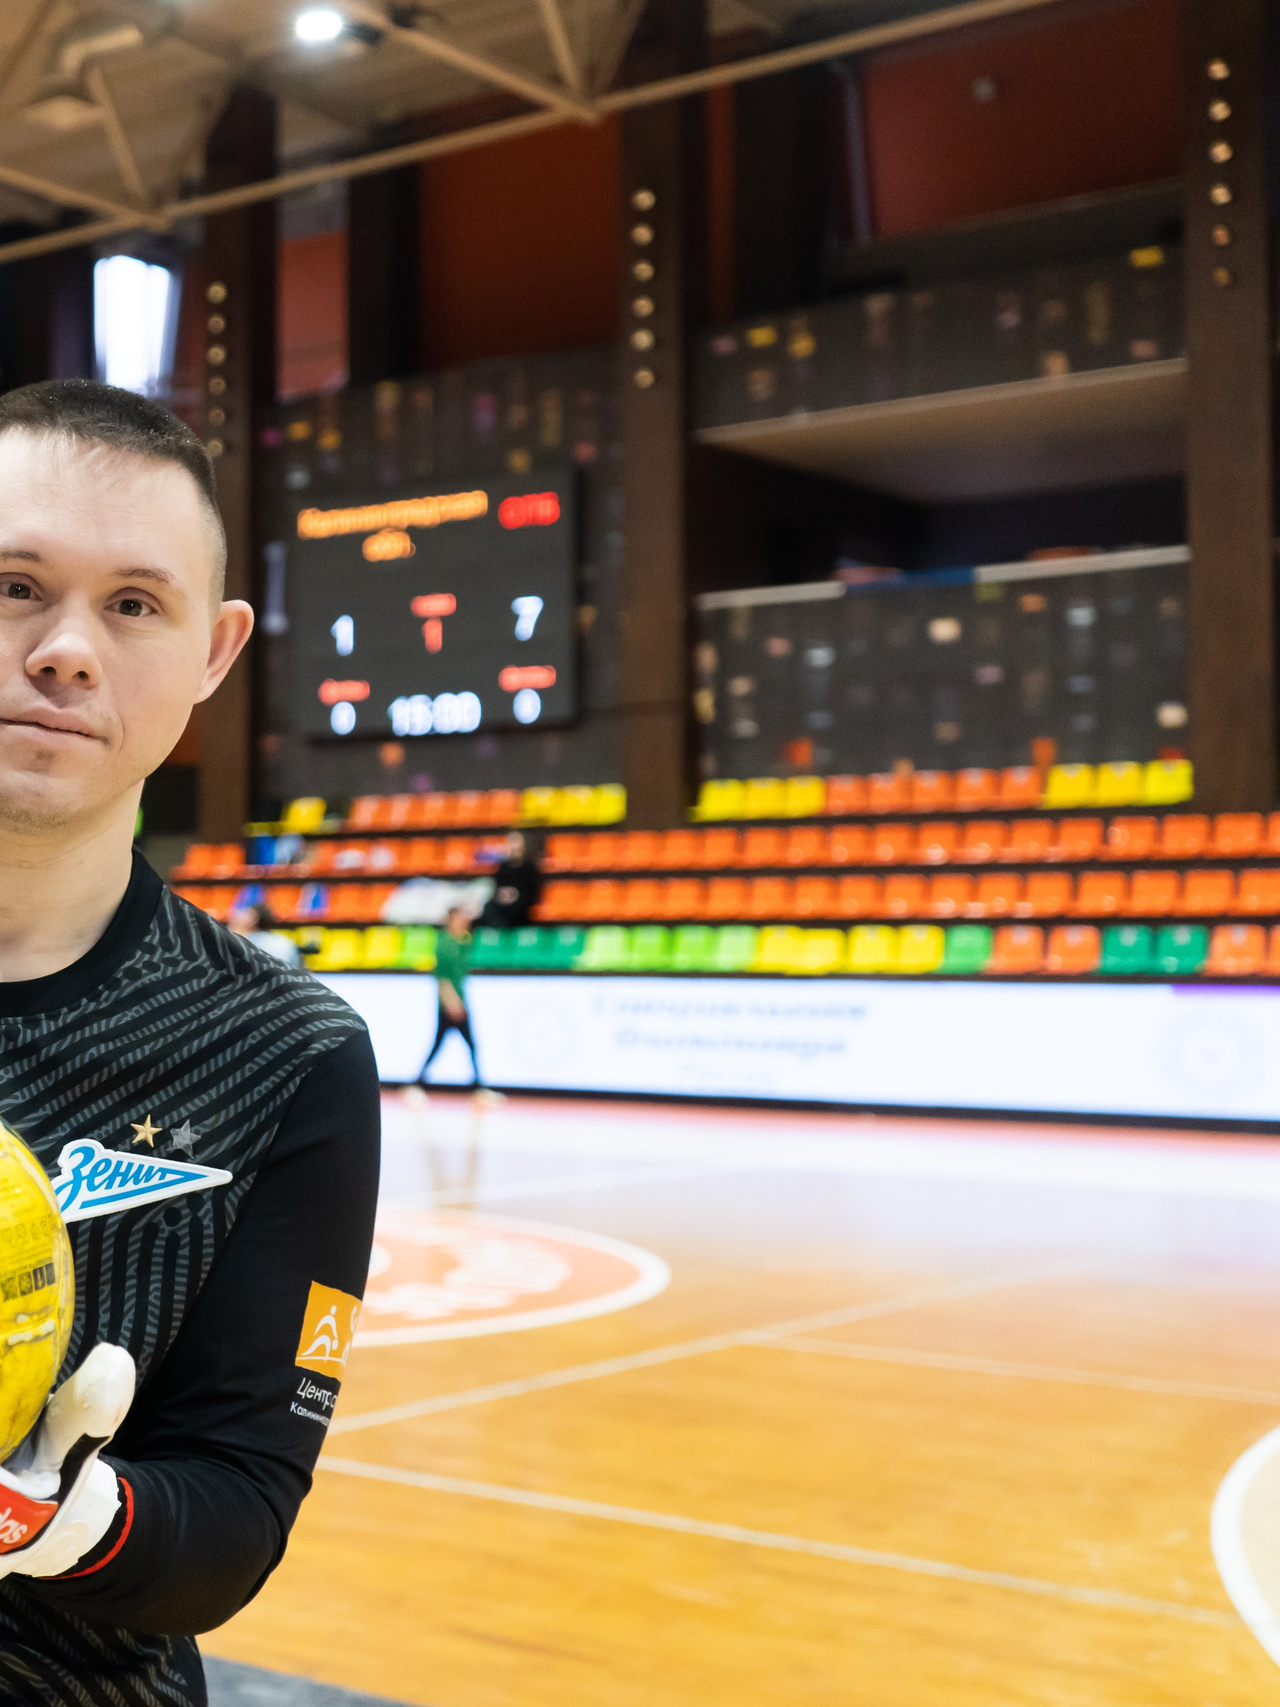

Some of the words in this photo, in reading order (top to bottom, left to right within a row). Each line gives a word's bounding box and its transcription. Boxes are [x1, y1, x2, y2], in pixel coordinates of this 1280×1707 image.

[330, 614, 354, 656] 1
[511, 595, 543, 641] 7
[55, 1146, 209, 1213] Зенит
